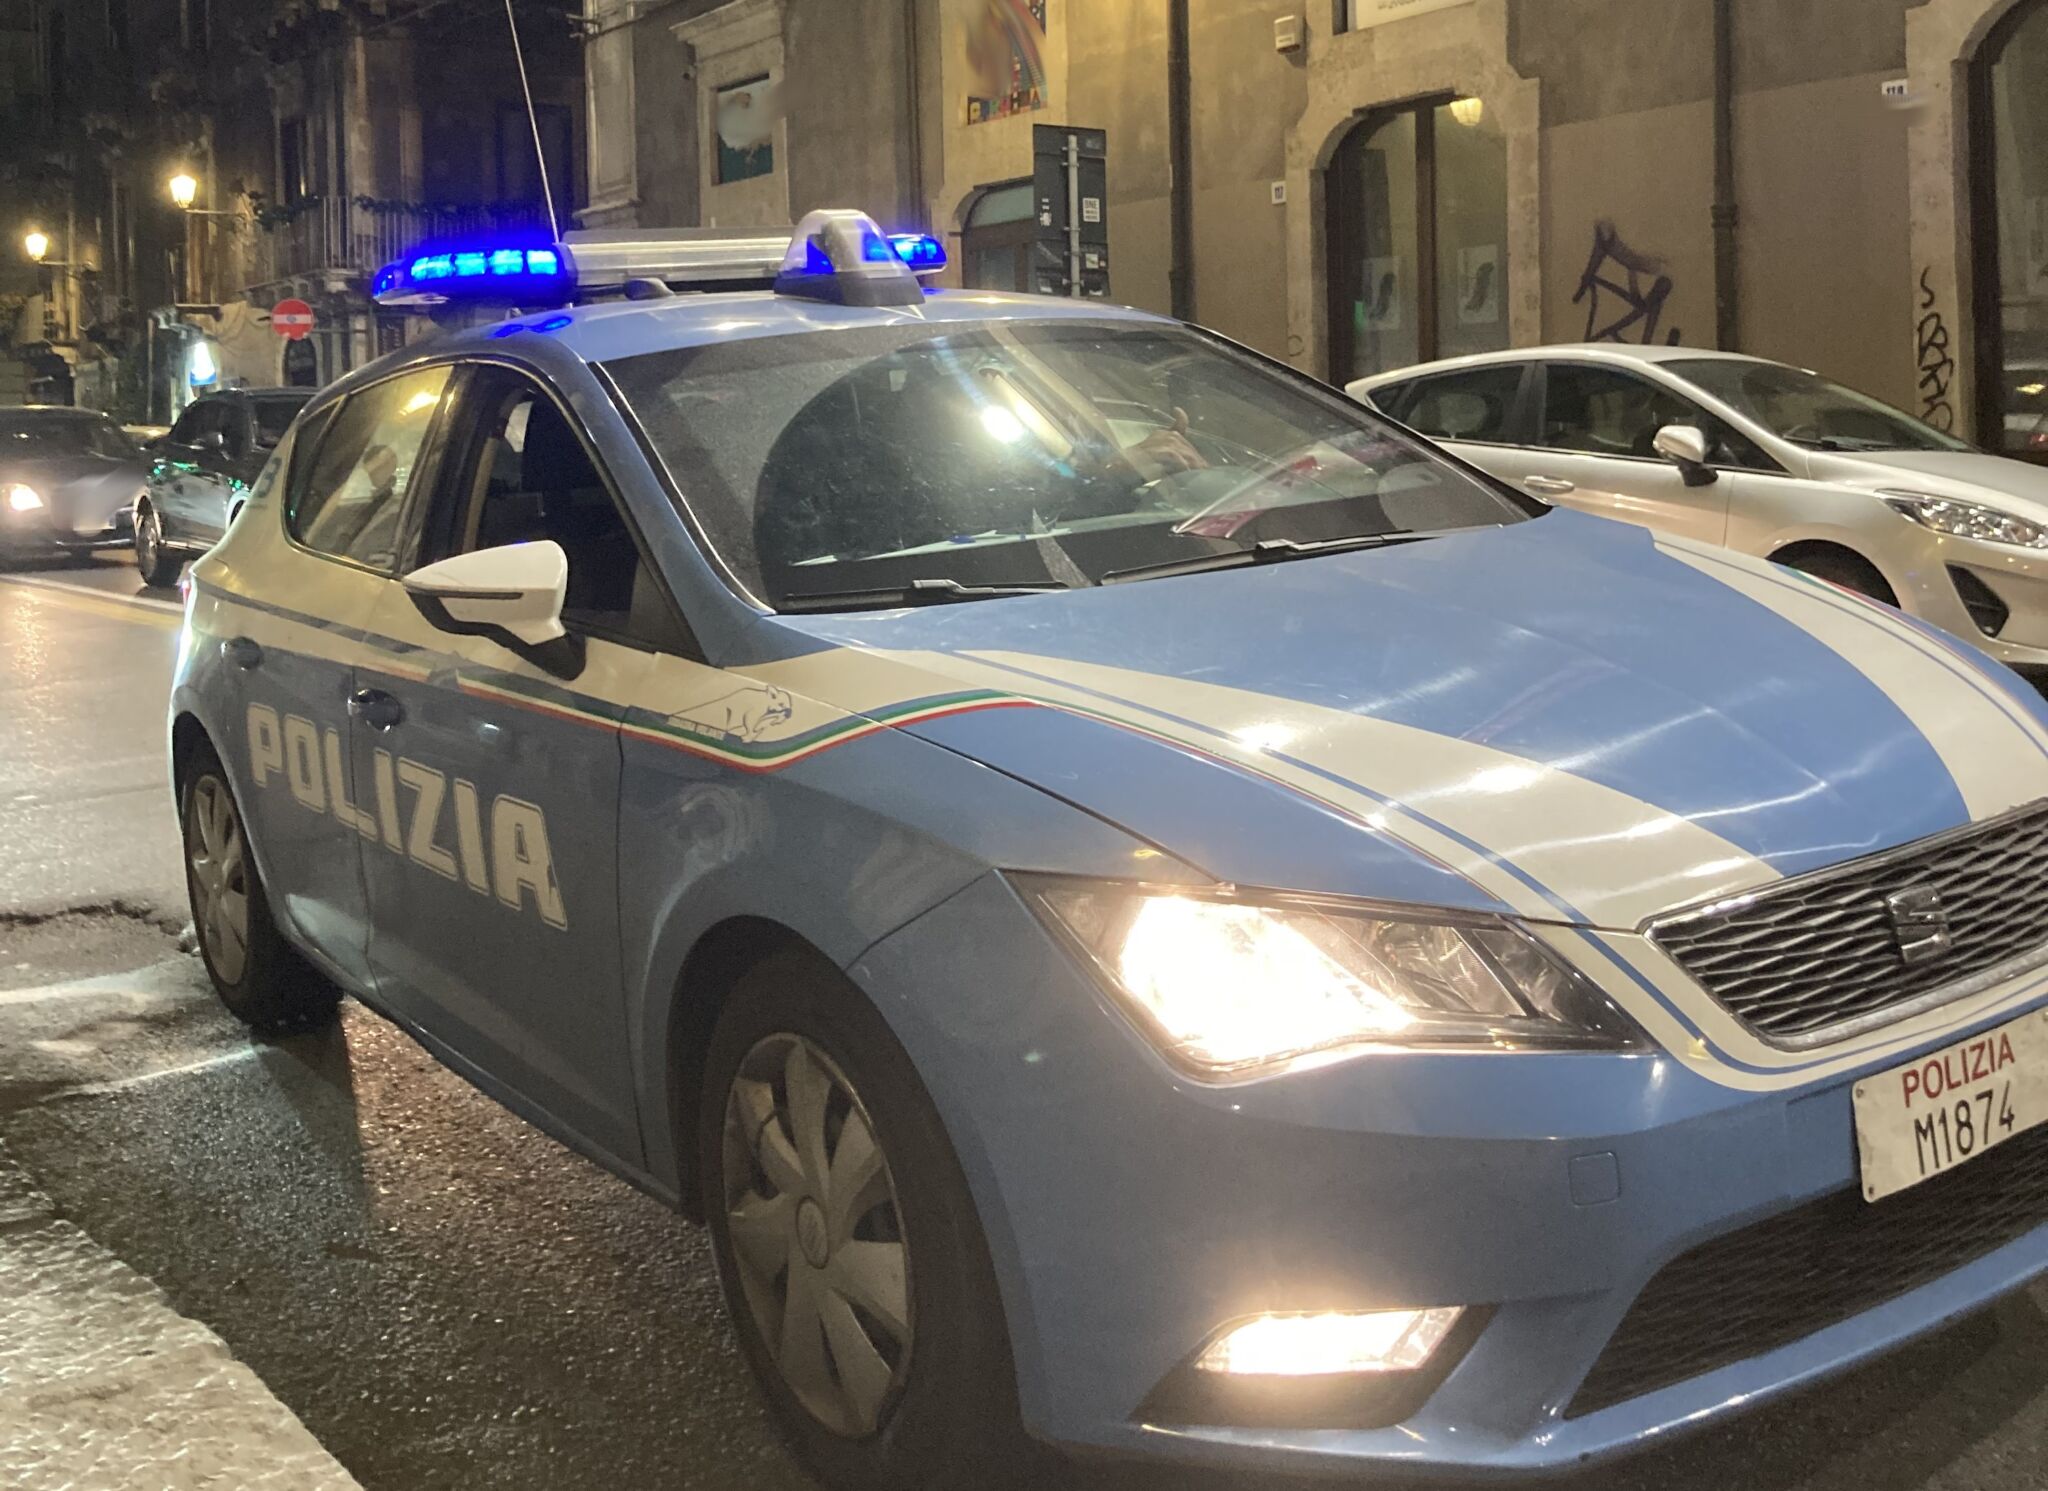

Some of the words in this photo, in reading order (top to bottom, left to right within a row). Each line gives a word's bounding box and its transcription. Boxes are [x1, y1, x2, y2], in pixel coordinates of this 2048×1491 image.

[246, 701, 568, 932] POLIZIA
[1902, 1031, 2016, 1109] POLIZIA
[1913, 1079, 2016, 1175] M1874
